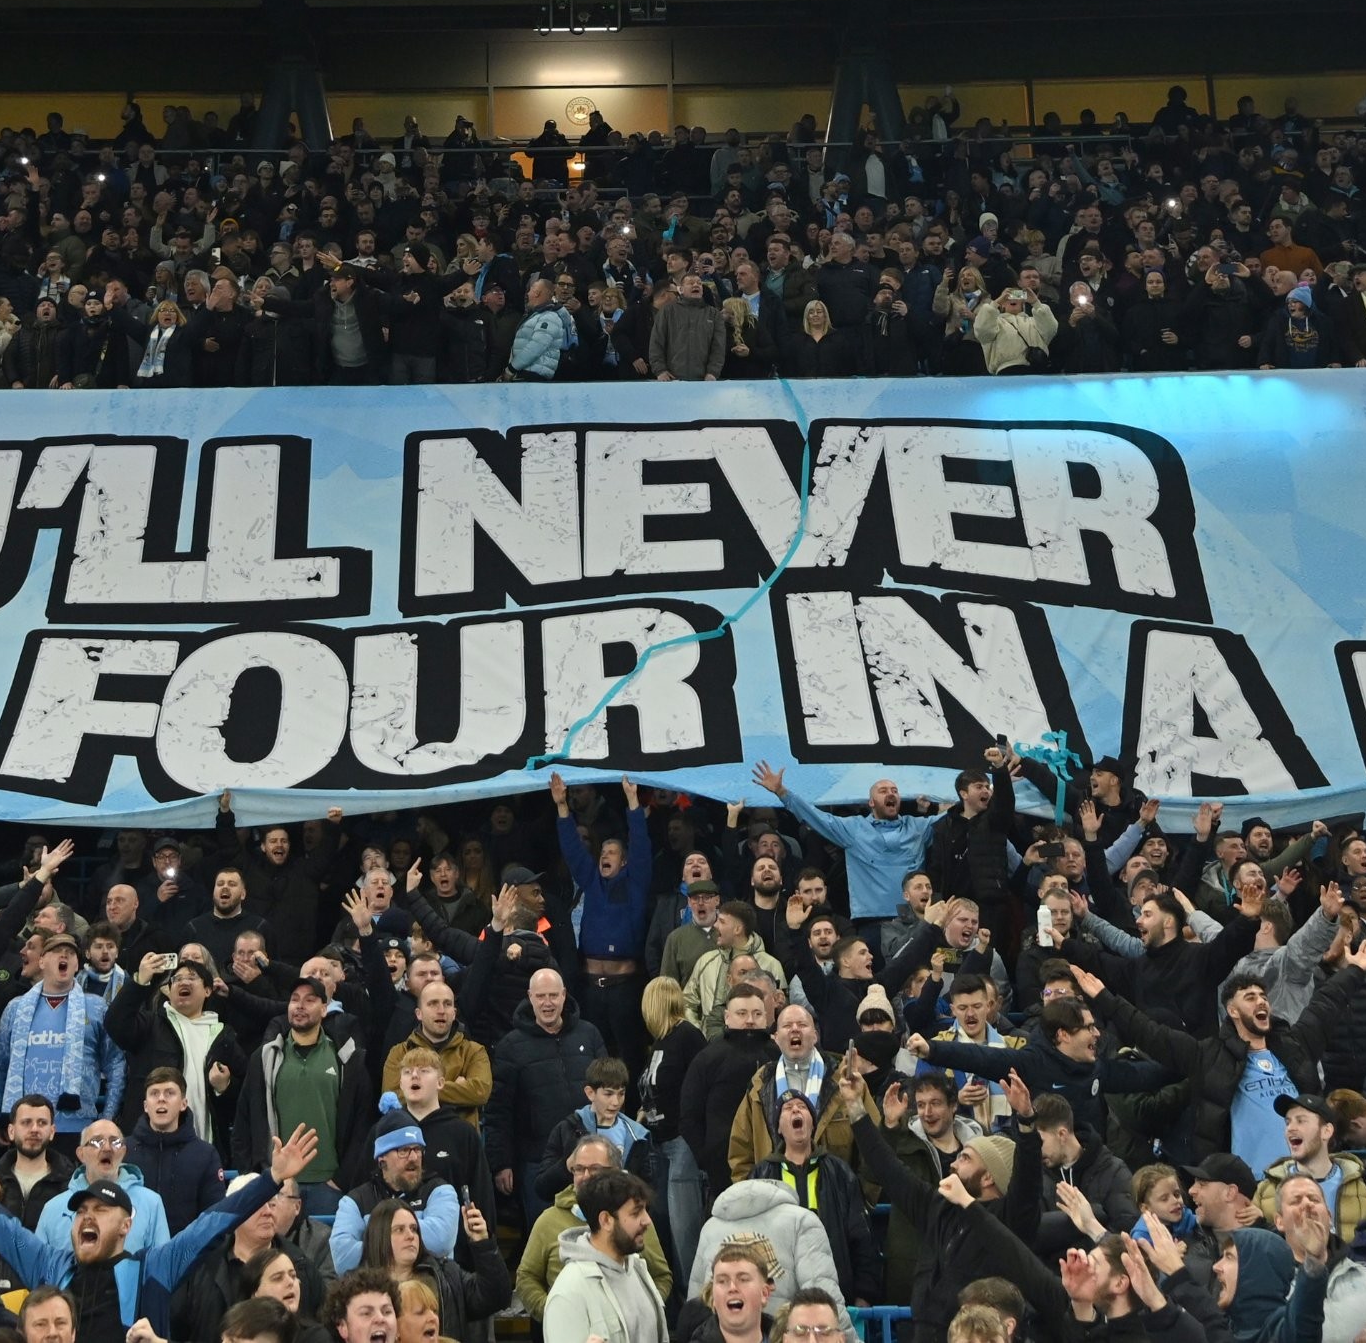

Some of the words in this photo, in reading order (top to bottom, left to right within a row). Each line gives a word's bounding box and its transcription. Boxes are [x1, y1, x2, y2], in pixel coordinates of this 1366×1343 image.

[413, 423, 1180, 600] NEVER
[784, 589, 1056, 750] IN
[1133, 627, 1299, 798] A
